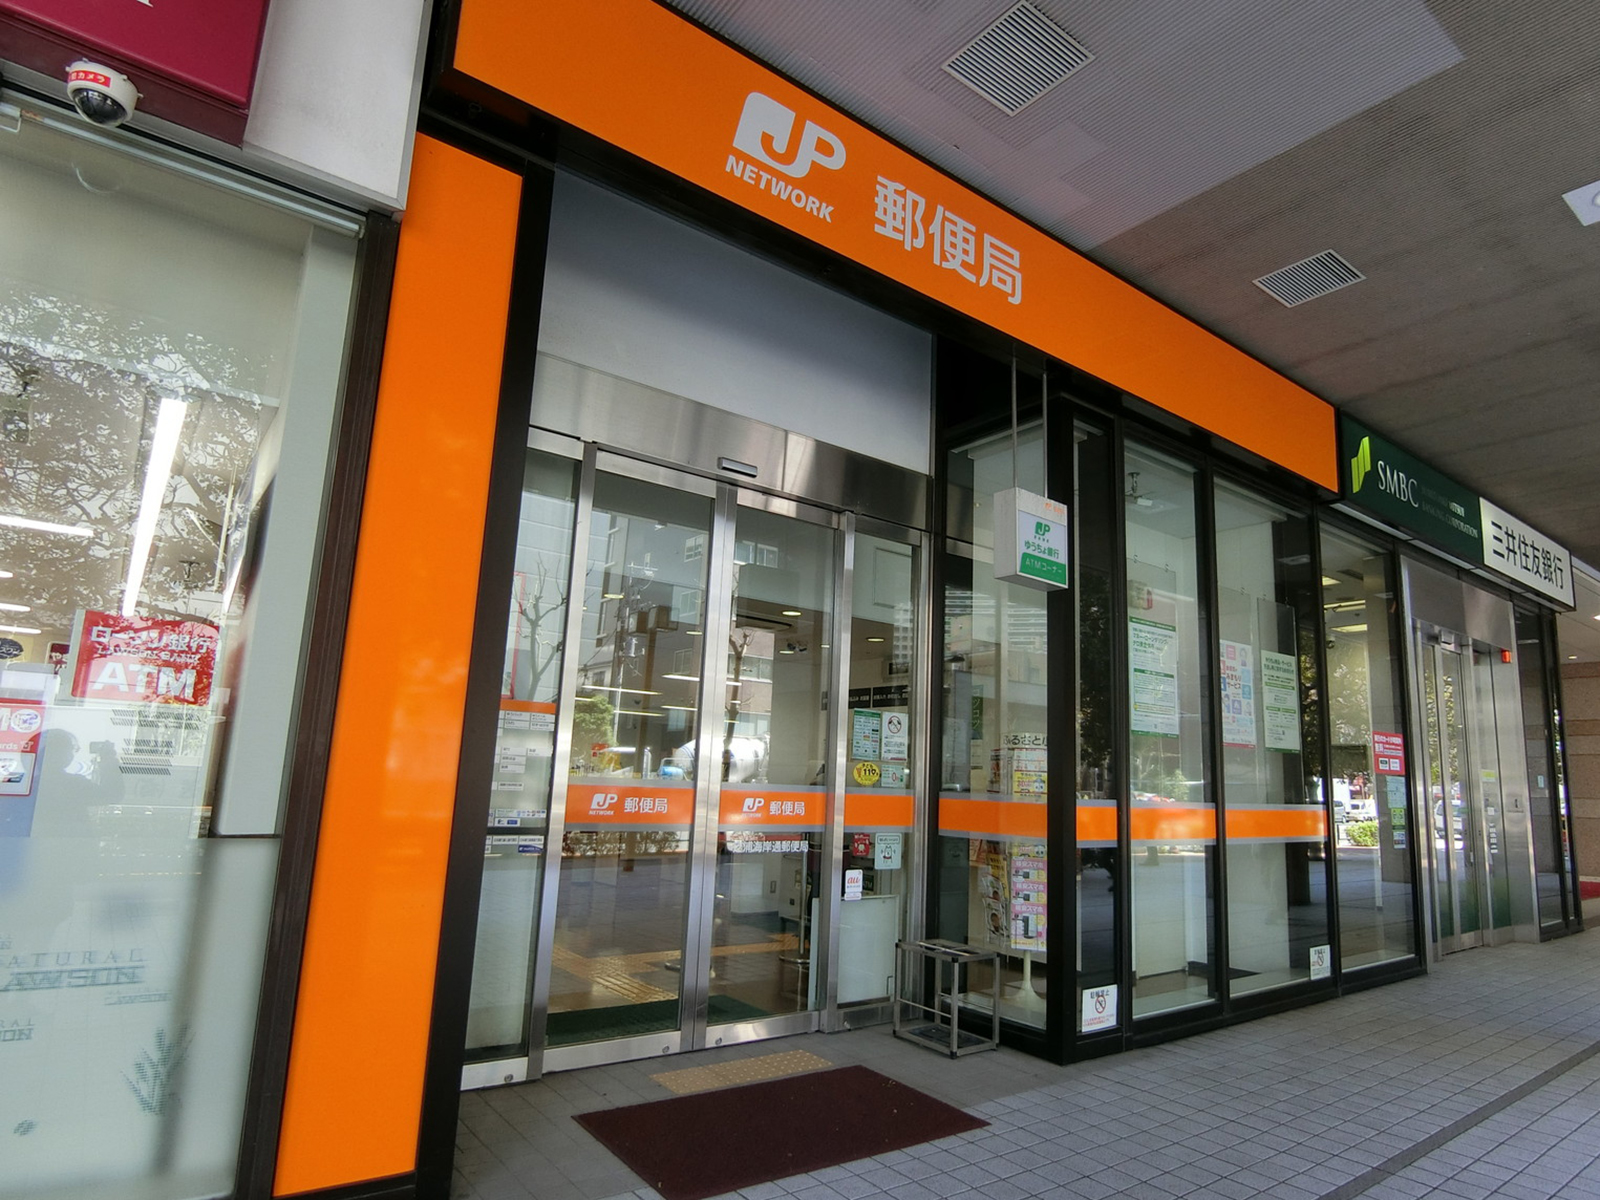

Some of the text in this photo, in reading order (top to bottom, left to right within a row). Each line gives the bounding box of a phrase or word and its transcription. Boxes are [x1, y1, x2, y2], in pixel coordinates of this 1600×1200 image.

[732, 91, 846, 178] JP
[725, 155, 834, 223] NETWORK
[874, 174, 1022, 305] 郵便局
[1377, 460, 1419, 508] SMBC
[1024, 540, 1060, 559] ゆうちょ銀行
[1025, 557, 1063, 573] ATMコーナー
[1491, 520, 1564, 590] 三井住友銀行
[92, 661, 197, 699] ATM
[624, 797, 668, 814] 郵便局
[769, 801, 806, 816] 郵便局
